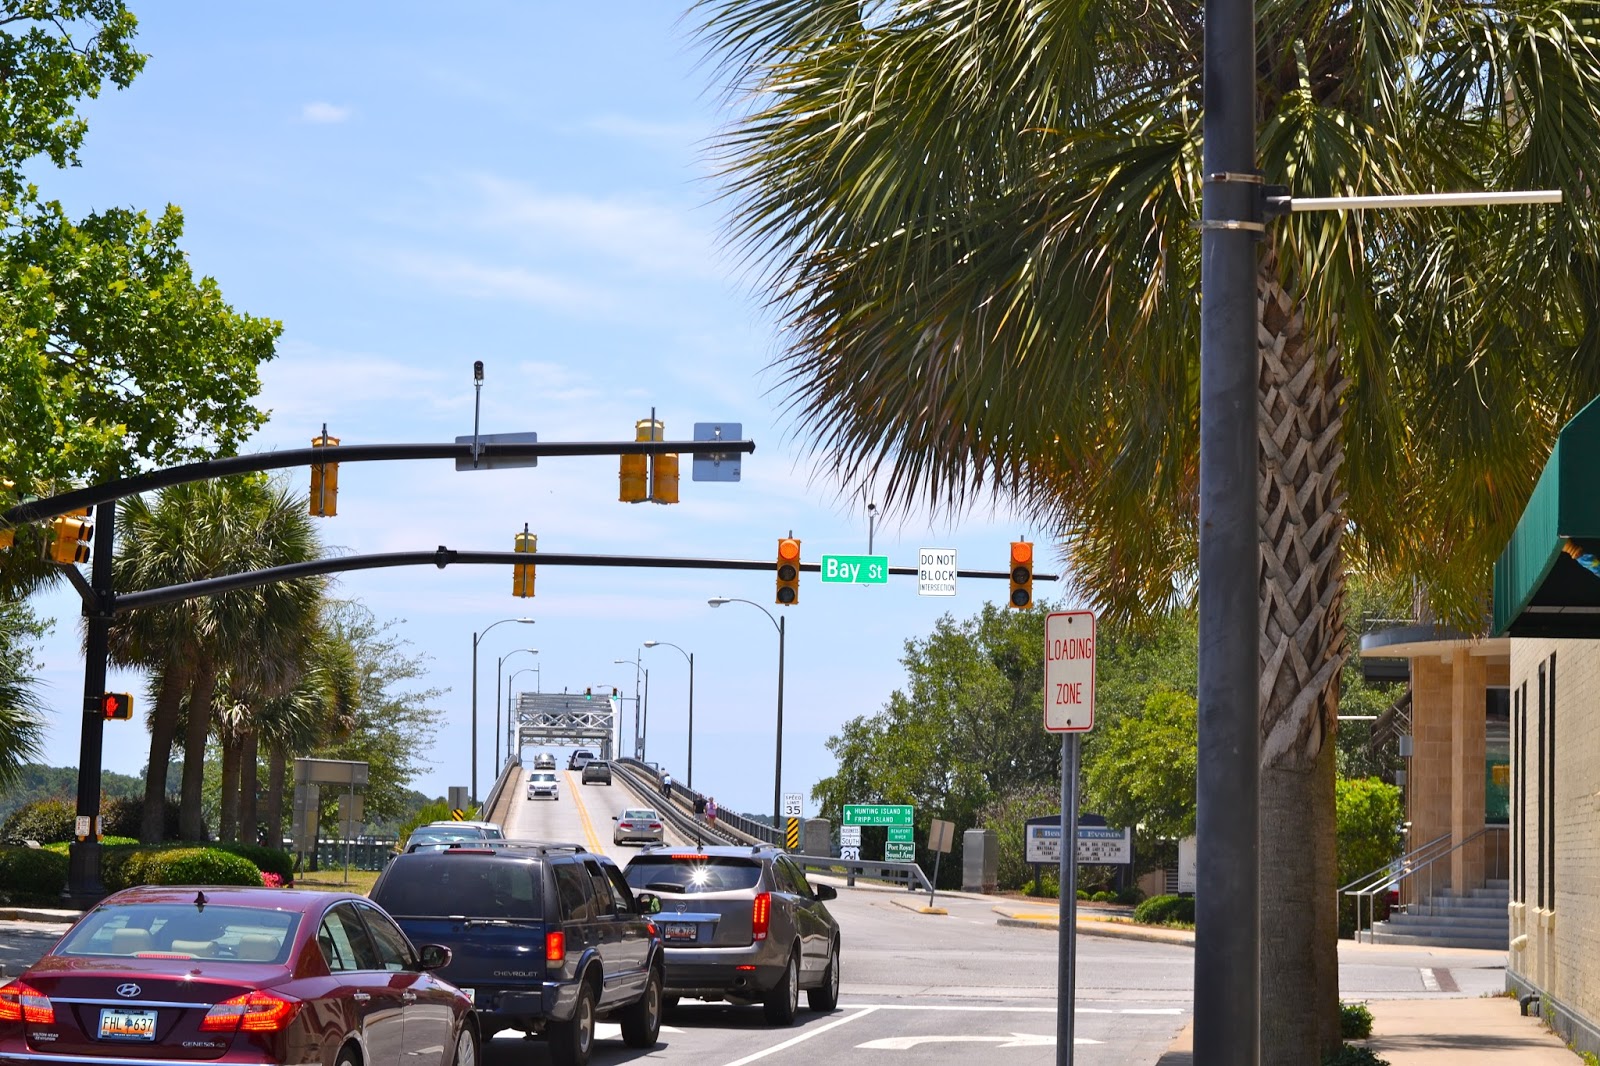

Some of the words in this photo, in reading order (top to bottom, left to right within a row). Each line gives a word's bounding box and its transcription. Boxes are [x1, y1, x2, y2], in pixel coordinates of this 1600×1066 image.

[921, 555, 934, 565] DO
[937, 555, 955, 566] NOT
[827, 558, 861, 583] Bay
[868, 564, 882, 579] St
[921, 570, 955, 581] BLOCK
[920, 583, 955, 592] INTERSECTION
[1048, 638, 1092, 661] LOADING
[1056, 683, 1082, 705] ZONE
[786, 806, 801, 815] 35
[841, 837, 860, 845] SOUTH
[103, 1016, 122, 1030] FHL
[133, 1018, 154, 1031] 637
